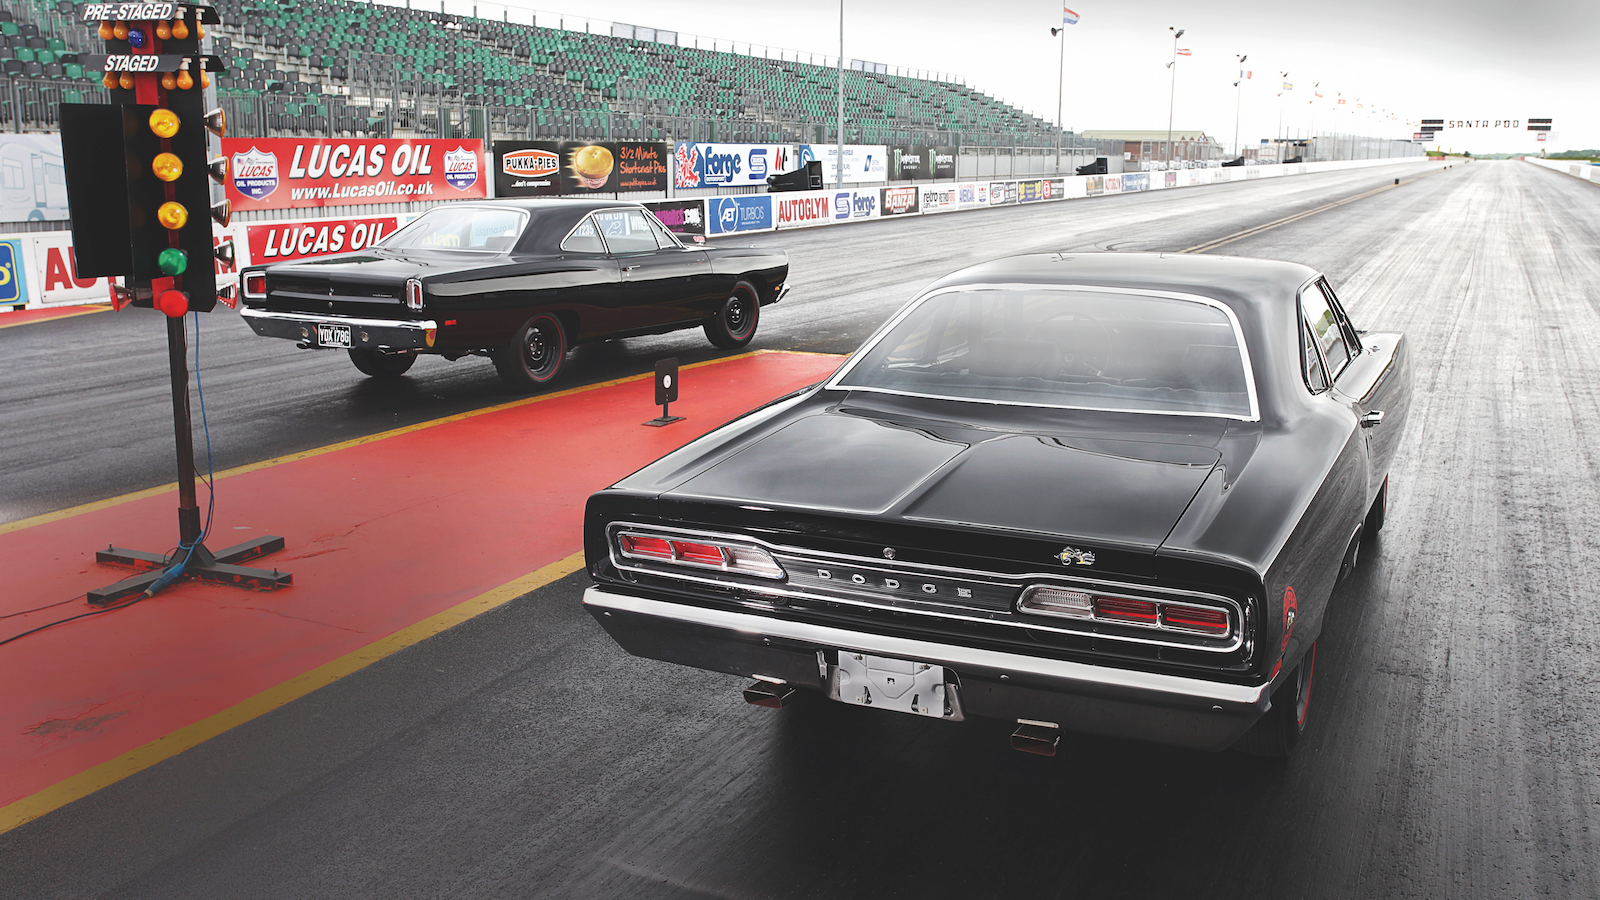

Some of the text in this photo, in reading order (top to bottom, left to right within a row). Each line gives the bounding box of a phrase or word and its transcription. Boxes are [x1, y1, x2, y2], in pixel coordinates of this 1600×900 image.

[83, 4, 172, 20] PRE-STAGED
[104, 55, 159, 71] STAGED
[1448, 120, 1489, 129] SANTA
[635, 145, 658, 160] Minute
[289, 144, 432, 179] LUCAS OIL
[448, 161, 475, 172] LUCAS
[620, 160, 667, 174] Shortcrust Pies
[238, 165, 274, 178] LUCAS
[235, 179, 276, 188] OIL PRODUCTS
[291, 182, 433, 200] www.LucasOil.co.uk
[740, 206, 764, 221] TURBOS
[779, 197, 829, 222] AUTOGLYM
[264, 224, 346, 258] LUCAS
[334, 330, 349, 343] 178G
[817, 568, 972, 598] DODGE
